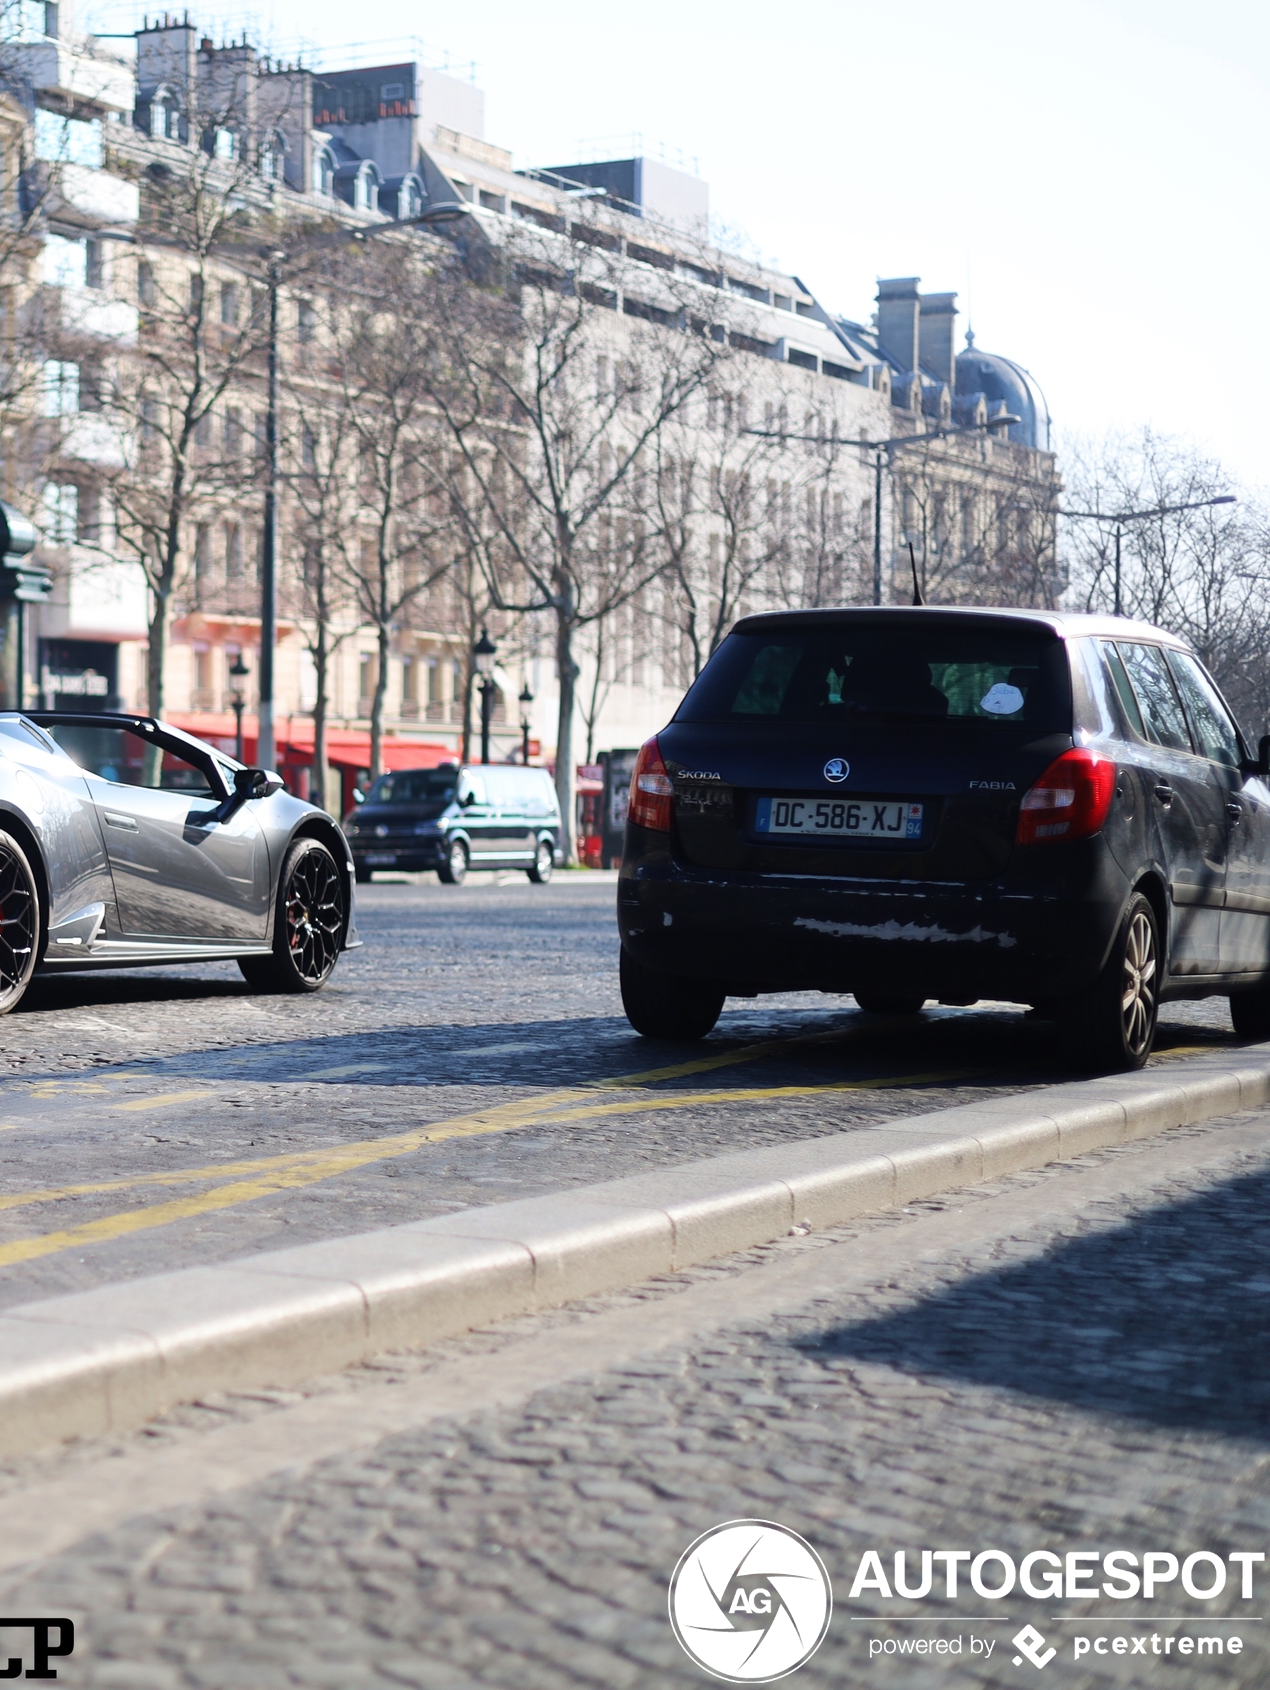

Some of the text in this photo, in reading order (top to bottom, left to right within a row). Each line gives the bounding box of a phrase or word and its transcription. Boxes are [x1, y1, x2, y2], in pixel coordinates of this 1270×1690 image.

[677, 769, 721, 780] ŠKODA
[969, 780, 1016, 790] FABIA
[774, 802, 903, 832] DC-586-XJ
[907, 822, 921, 835] 94
